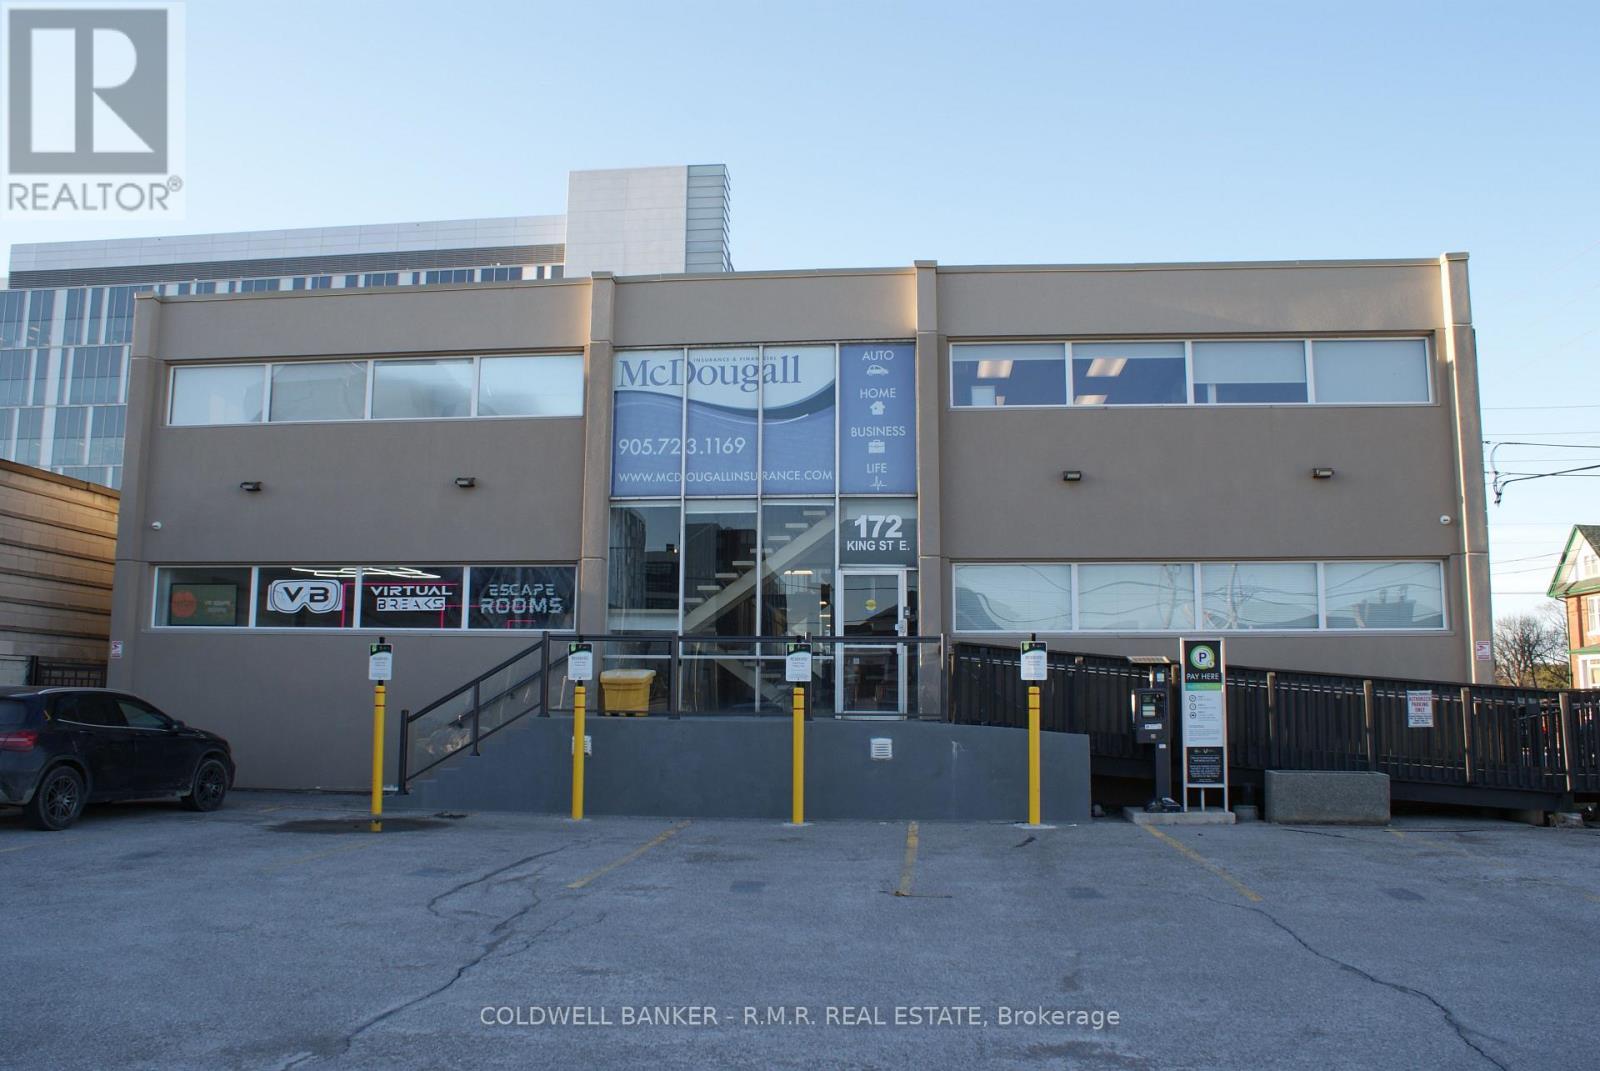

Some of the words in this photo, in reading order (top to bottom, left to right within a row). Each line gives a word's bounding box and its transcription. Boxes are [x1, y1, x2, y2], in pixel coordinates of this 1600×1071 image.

[862, 350, 895, 361] AUTO
[618, 354, 801, 392] McDougall
[859, 387, 897, 399] HOME
[850, 426, 906, 438] BUSINESS
[618, 437, 746, 456] 905.723.1169
[866, 462, 888, 474] LIFE
[854, 514, 903, 538] 172
[847, 540, 876, 551] KING
[879, 540, 895, 551] ST
[899, 540, 910, 551] E.
[283, 586, 330, 603] VB
[370, 585, 453, 596] VIRTUAL
[488, 583, 555, 596] ESCAPE
[378, 598, 444, 610] BREAKS
[480, 597, 562, 614] ROOMS
[1186, 672, 1199, 680] PAY
[1201, 672, 1219, 680] HERE
